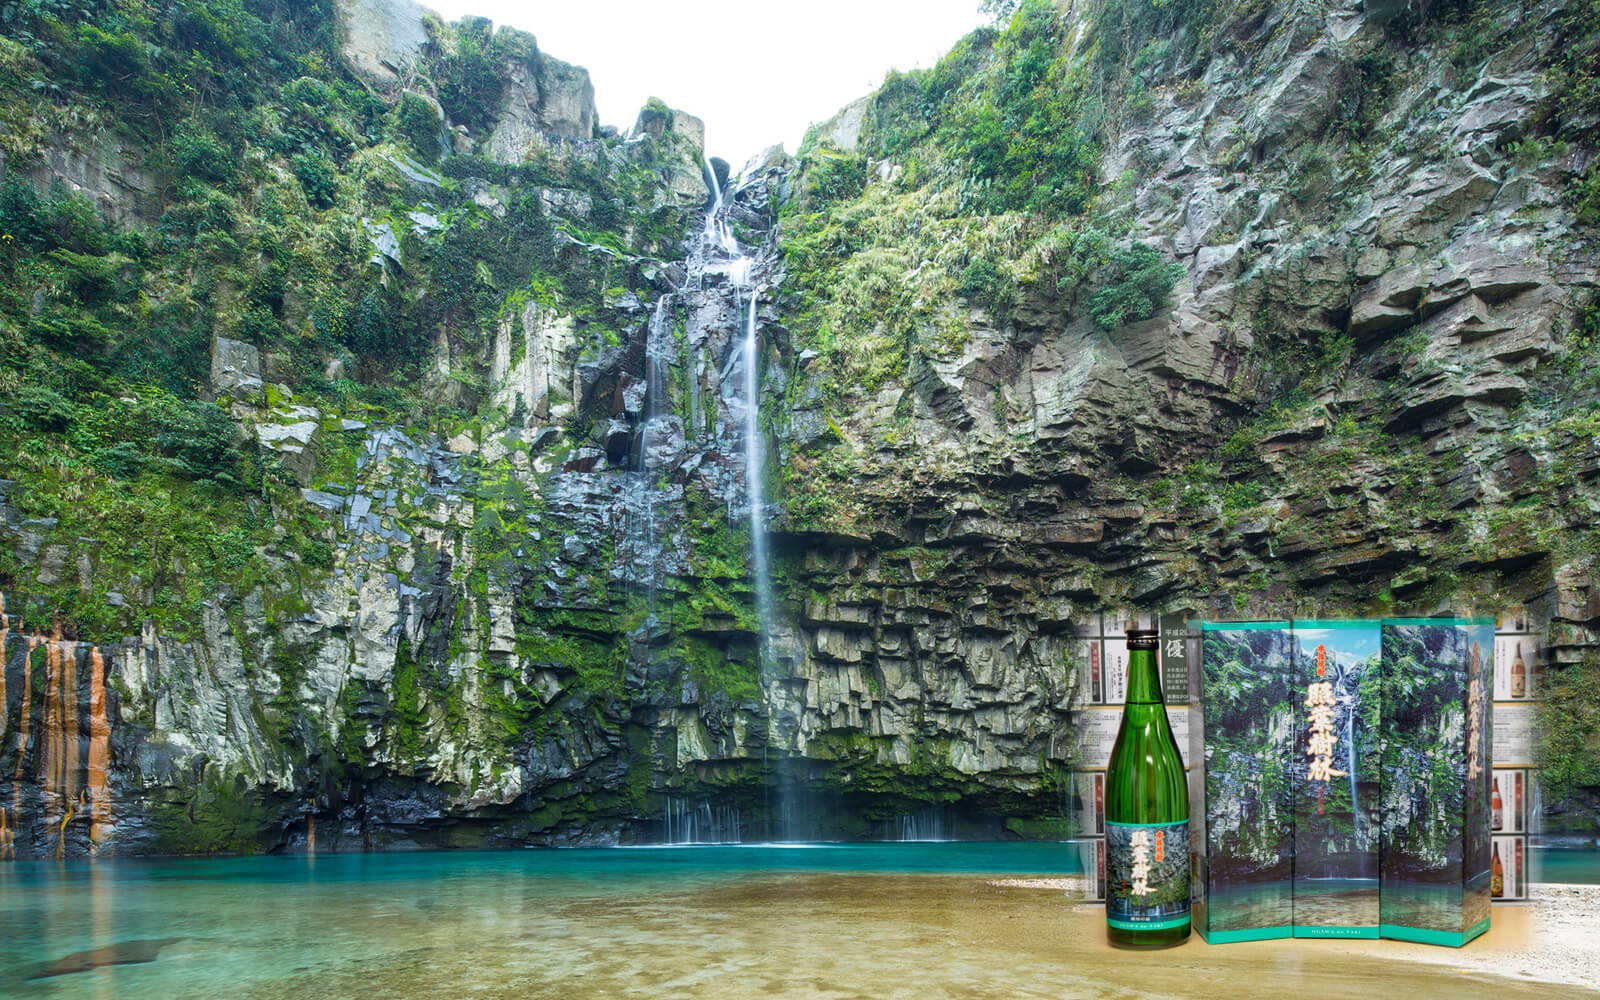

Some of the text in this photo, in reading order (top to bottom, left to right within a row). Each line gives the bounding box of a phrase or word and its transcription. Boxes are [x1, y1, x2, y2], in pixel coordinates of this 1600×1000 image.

[1304, 681, 1348, 782] 照葉樹林
[1129, 831, 1158, 896] 照葉樹林
